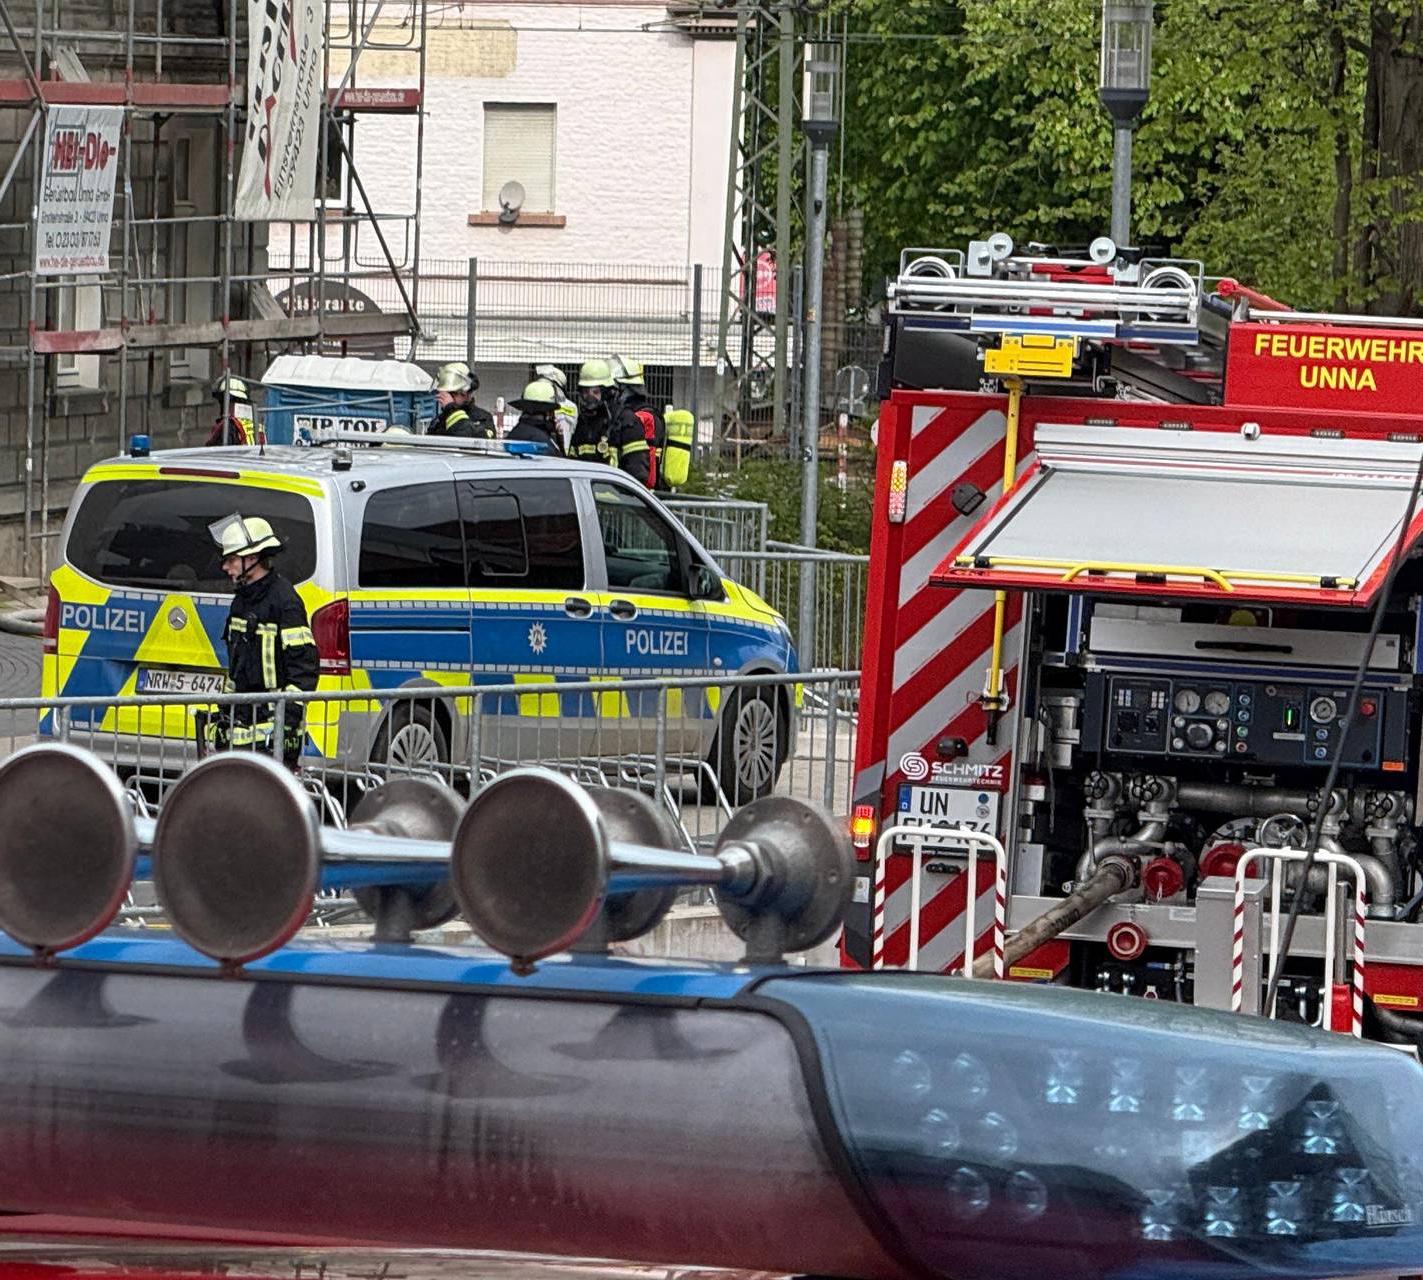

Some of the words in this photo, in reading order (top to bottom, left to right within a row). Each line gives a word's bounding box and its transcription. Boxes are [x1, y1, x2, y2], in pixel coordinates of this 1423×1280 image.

[302, 48, 318, 110] Unna
[1254, 333, 1423, 364] FEUERWEHR
[1300, 365, 1377, 391] UNNA
[61, 604, 146, 633] POLIZEI
[626, 629, 689, 656] POLIZEI
[145, 668, 171, 690] NRW
[931, 761, 1004, 778] SCHMITZ
[920, 791, 949, 816] UN
